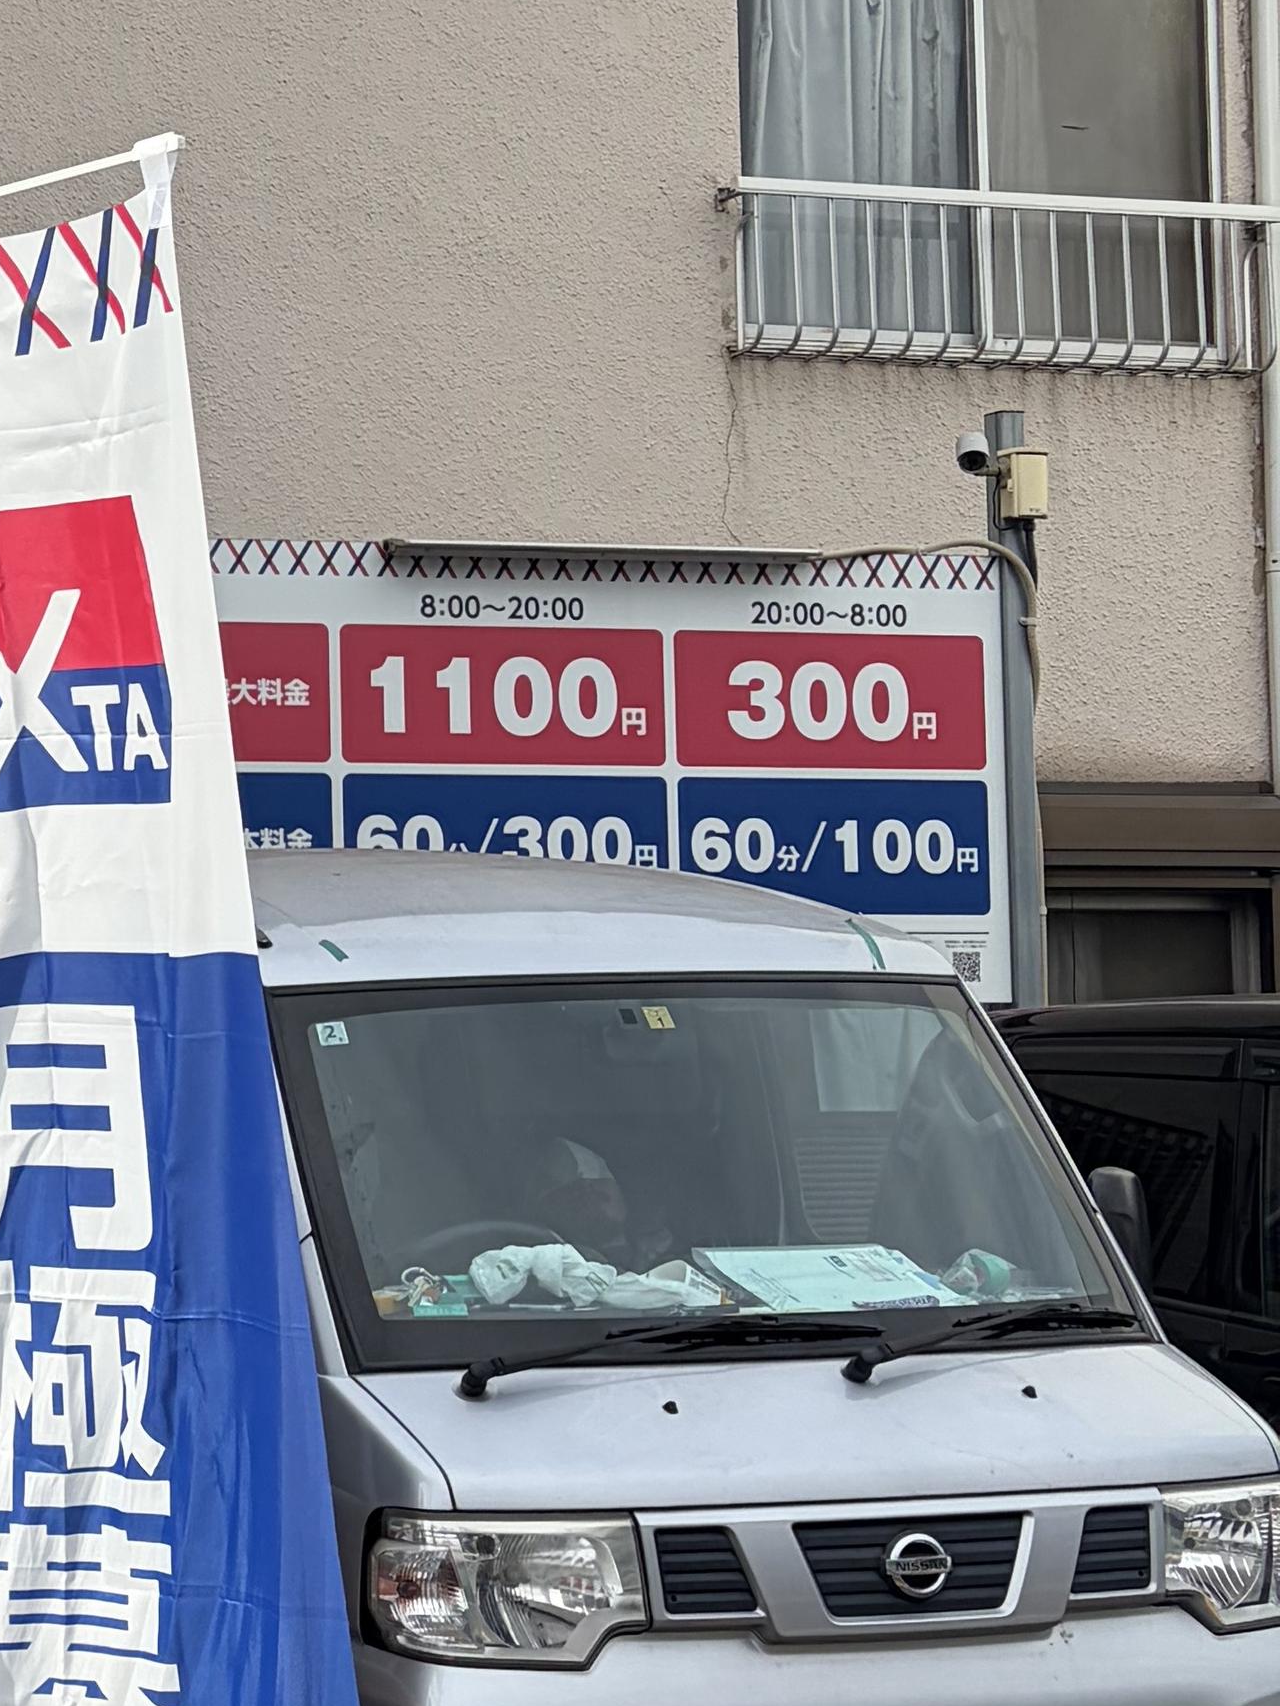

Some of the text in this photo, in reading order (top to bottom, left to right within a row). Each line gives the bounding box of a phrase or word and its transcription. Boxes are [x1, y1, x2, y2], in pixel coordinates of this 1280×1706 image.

[419, 594, 585, 622] 8:00～20:00
[750, 600, 908, 628] 20:00～8:00
[225, 677, 311, 707] 大料金
[895, 1557, 947, 1572] NISSAN
